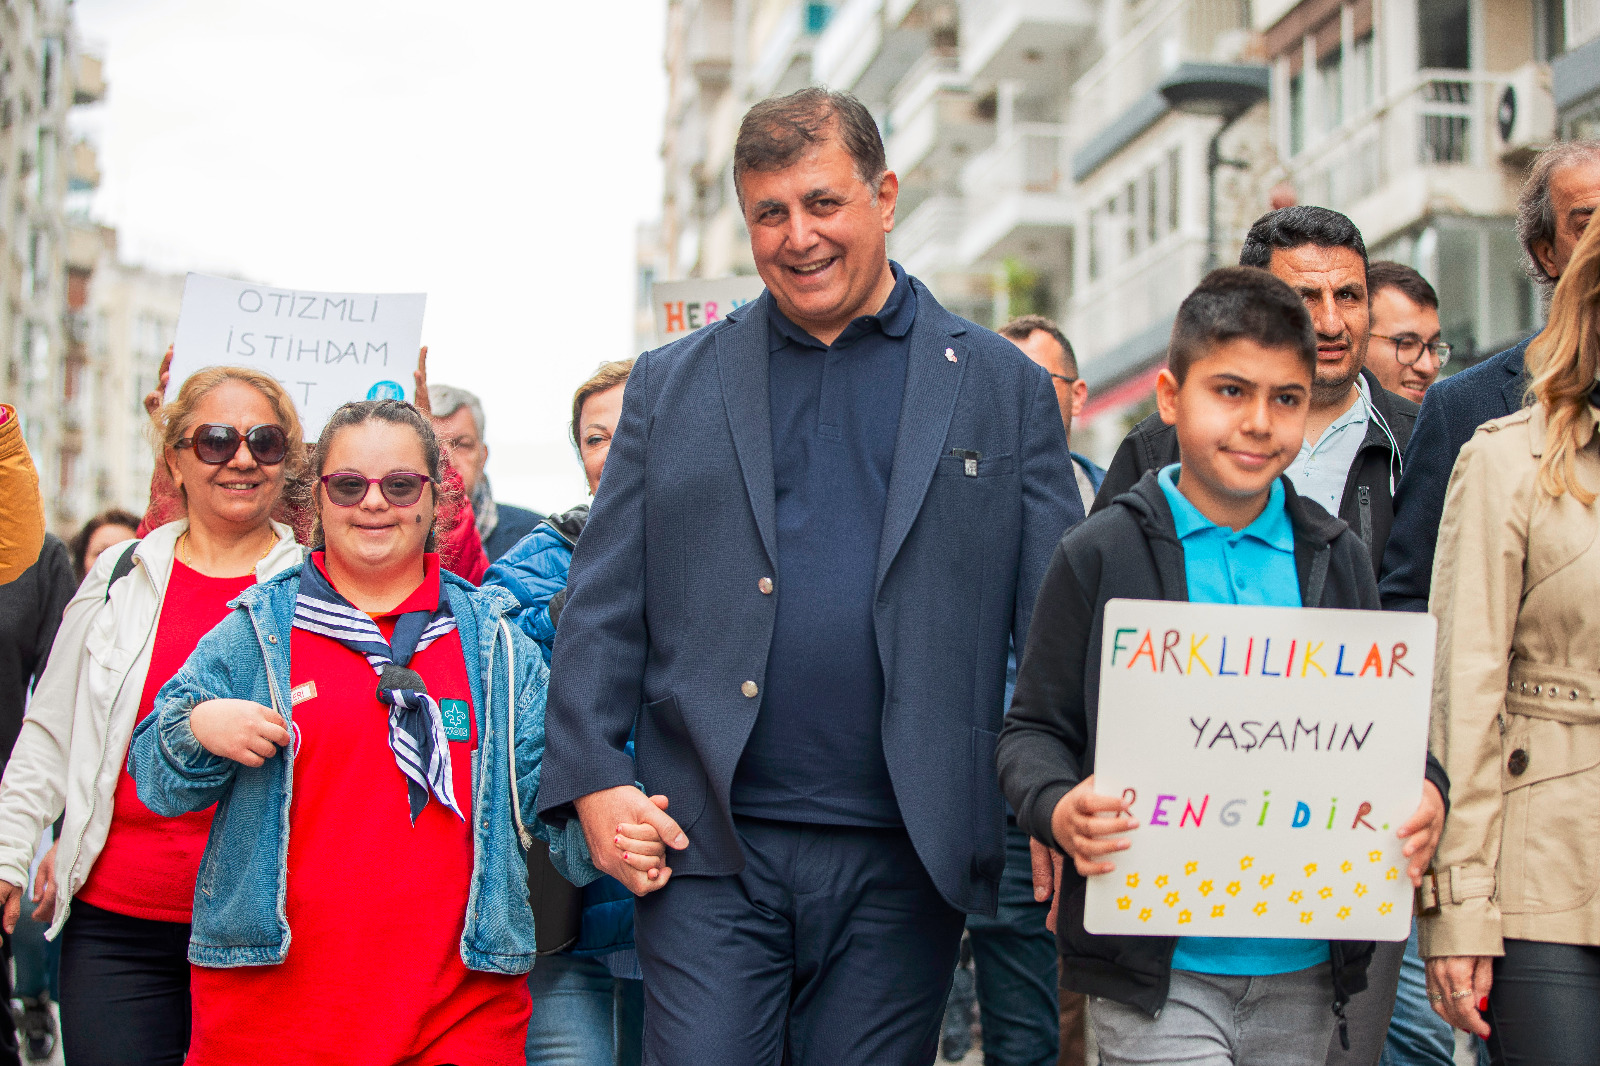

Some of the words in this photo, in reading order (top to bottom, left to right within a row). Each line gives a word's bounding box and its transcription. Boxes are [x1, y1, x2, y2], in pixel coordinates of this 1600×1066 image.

[238, 289, 378, 323] OTİZMLİ
[664, 301, 719, 333] HER
[226, 325, 388, 366] İSTİHDAM
[1111, 628, 1414, 678] FARKLILIKLAR
[1190, 716, 1374, 752] YAŞAMIN
